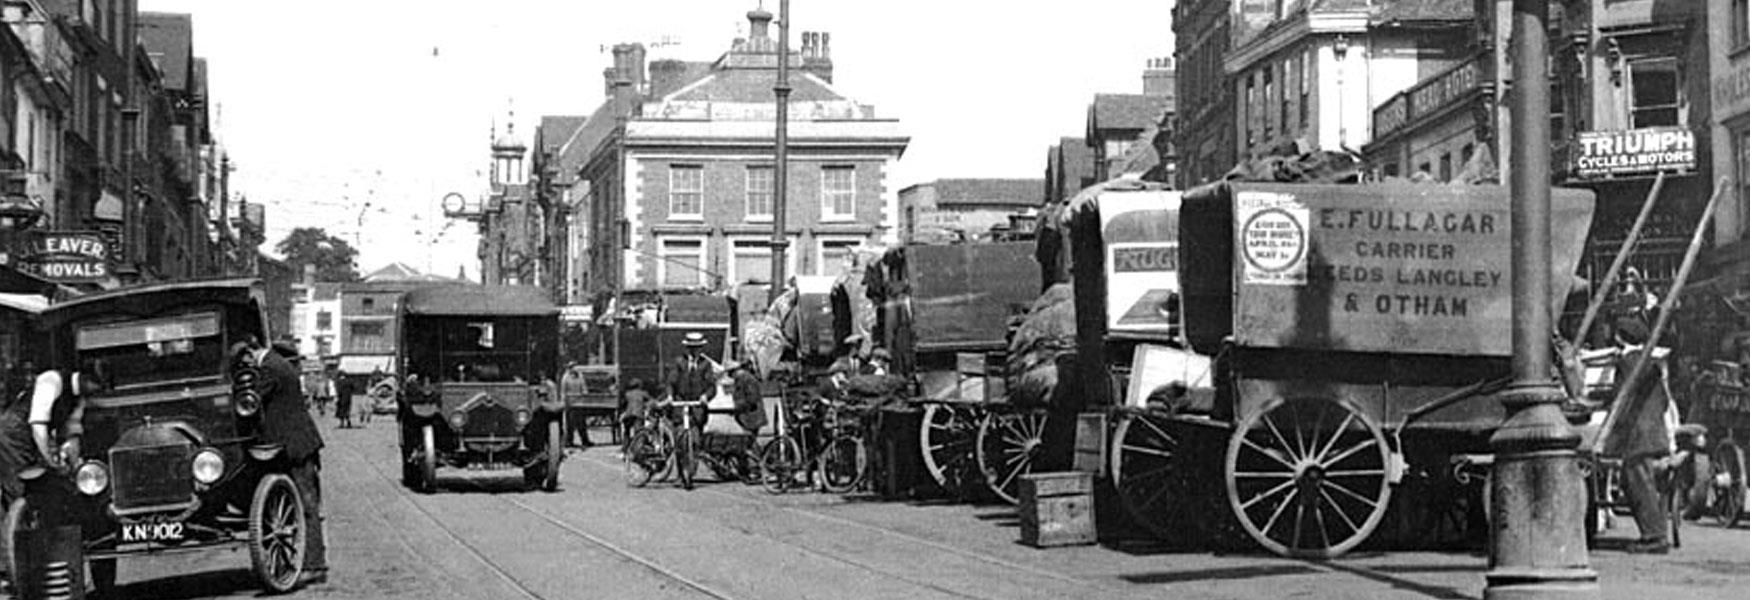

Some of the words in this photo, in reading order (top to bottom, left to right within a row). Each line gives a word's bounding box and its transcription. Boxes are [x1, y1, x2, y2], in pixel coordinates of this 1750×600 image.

[1579, 131, 1695, 156] TRIUMPH
[1578, 154, 1628, 169] CYCLES
[1637, 150, 1695, 165] MOTORS
[1355, 241, 1456, 260] CARRIER
[16, 261, 106, 278] REMOVALS
[1311, 264, 1384, 283] EEDS
[1396, 266, 1501, 288] LANGLEY
[1344, 292, 1359, 313] &
[1375, 294, 1468, 317] OTHAM
